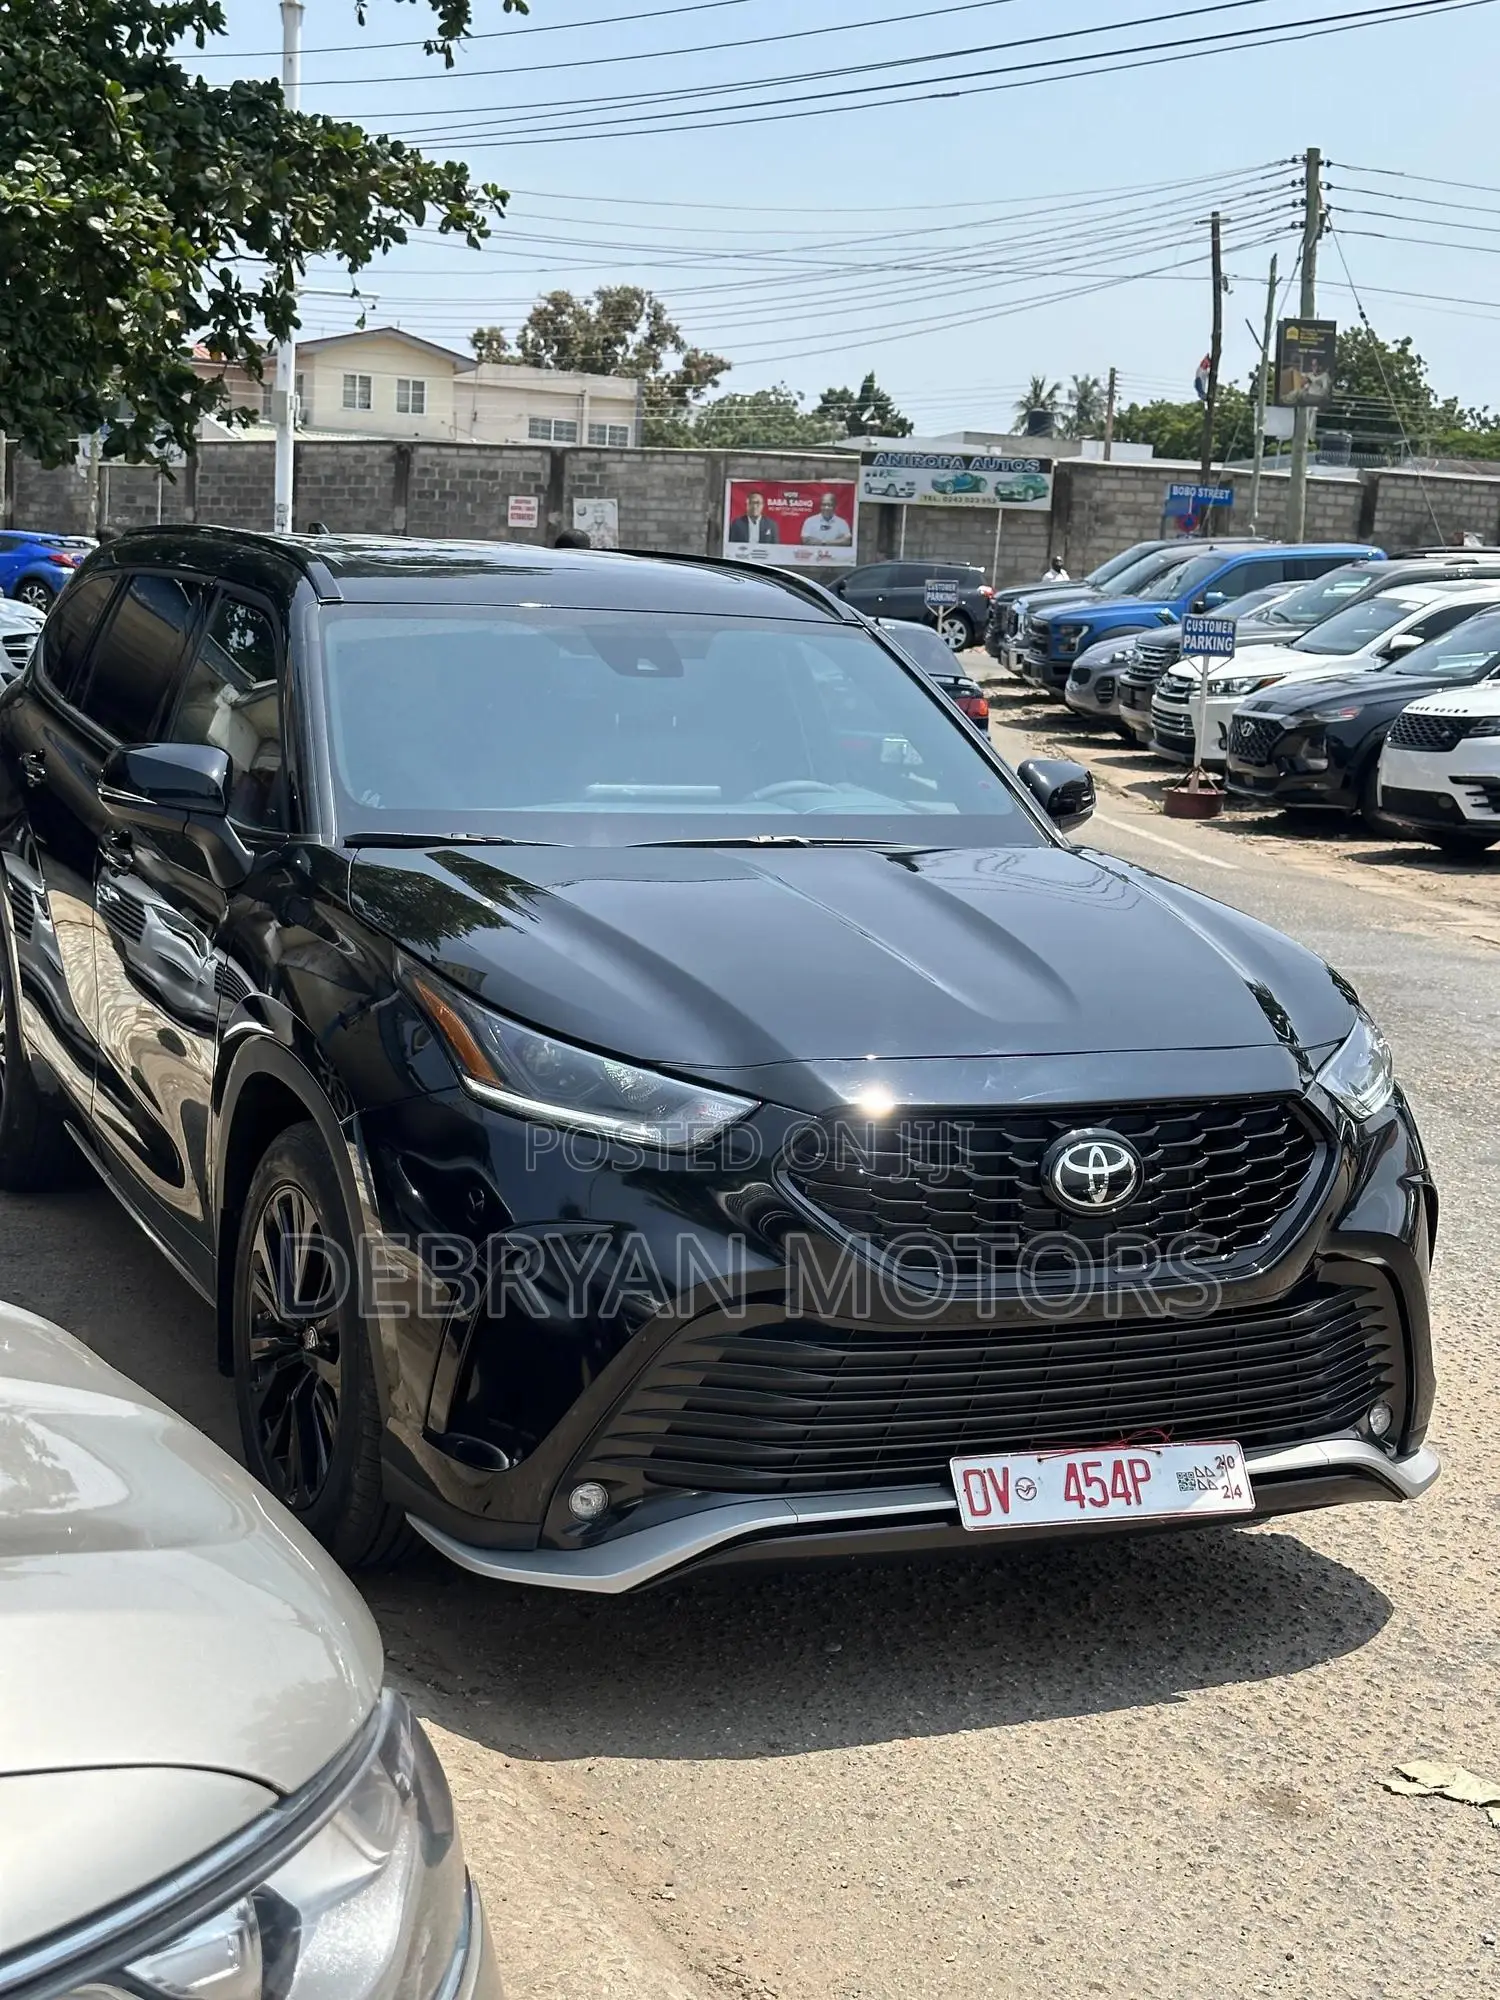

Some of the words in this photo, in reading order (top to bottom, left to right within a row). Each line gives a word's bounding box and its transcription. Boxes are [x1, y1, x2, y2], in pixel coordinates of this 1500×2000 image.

[872, 453, 965, 469] ANIROPA
[969, 456, 1040, 473] AUTOS
[1172, 485, 1196, 497] BOBO
[1198, 487, 1230, 500] STREET
[926, 591, 957, 602] PARKING
[1186, 619, 1233, 634] CUSTOMER
[1184, 634, 1233, 651] PARKING
[963, 1467, 1010, 1516] DV
[1064, 1459, 1151, 1509] 454P
